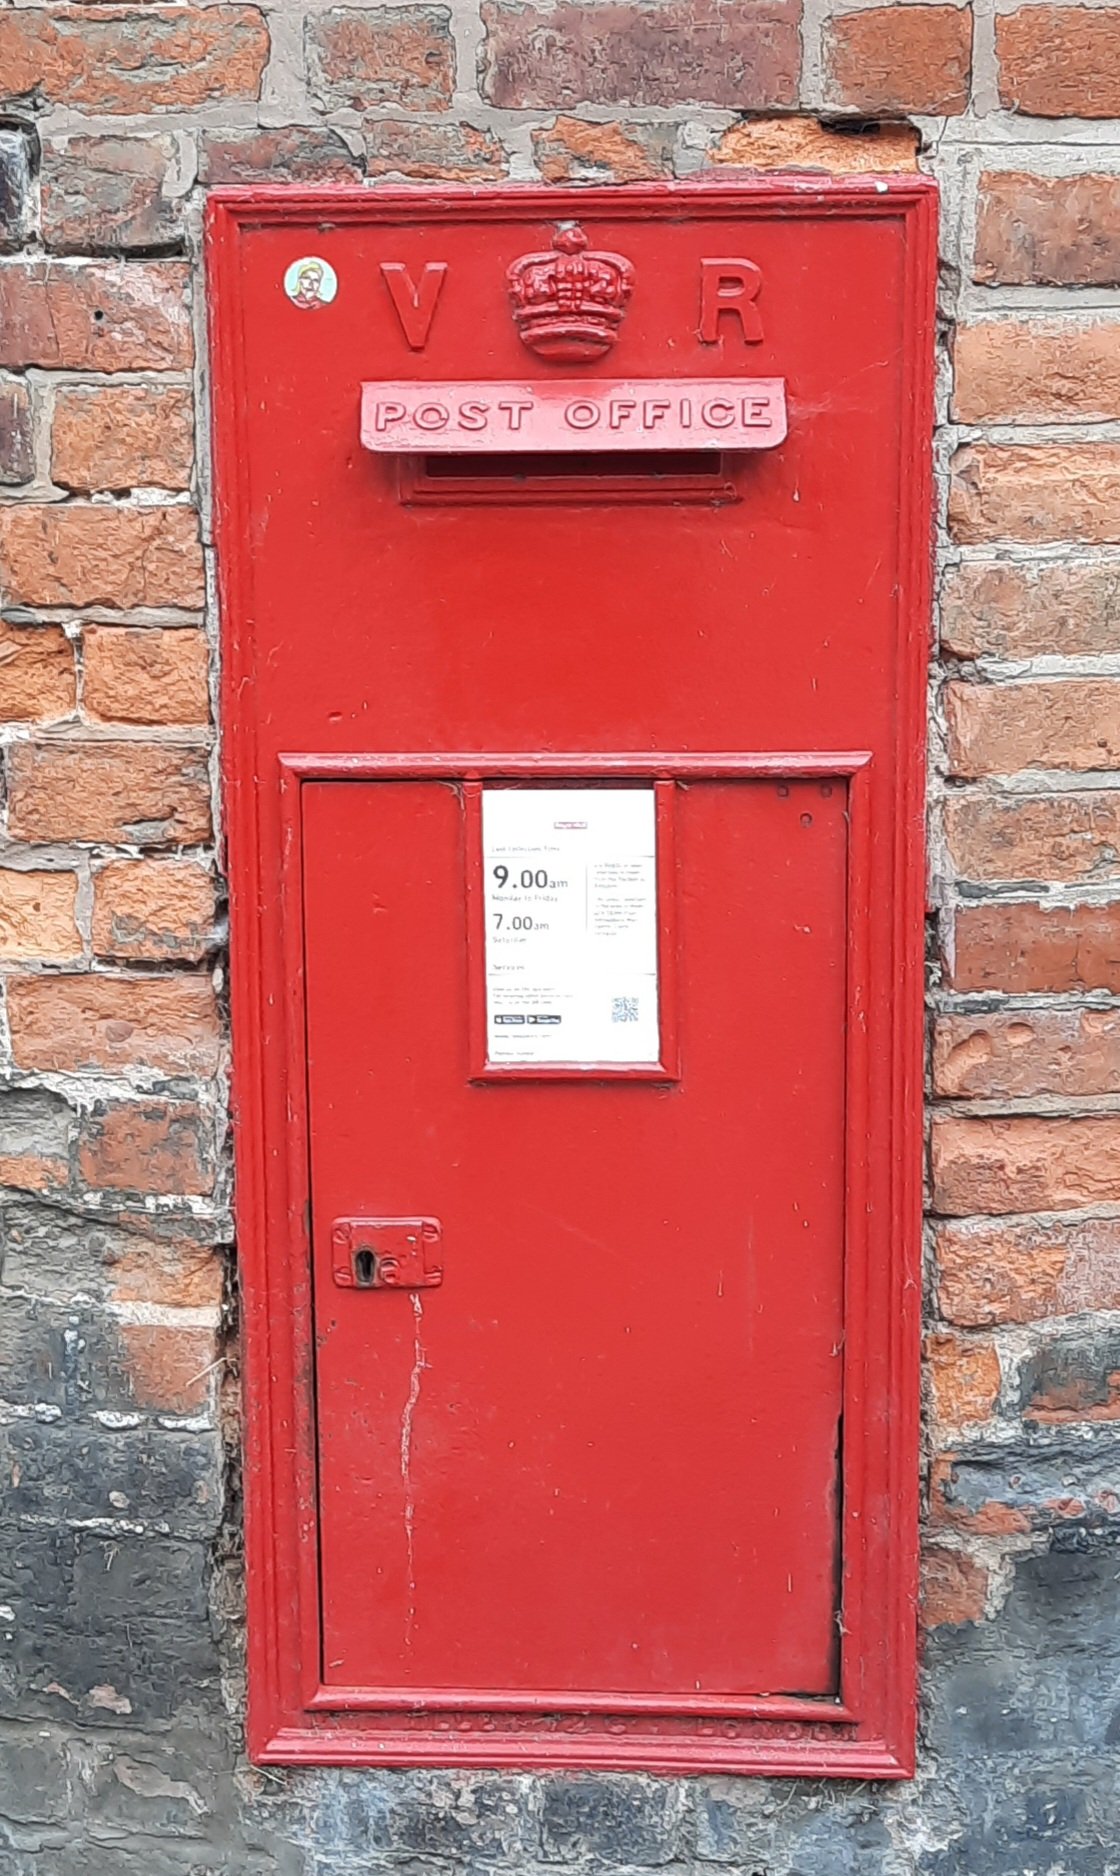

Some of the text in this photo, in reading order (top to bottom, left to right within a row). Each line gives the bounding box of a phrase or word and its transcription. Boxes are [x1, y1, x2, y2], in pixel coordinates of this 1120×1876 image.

[379, 256, 764, 351] V R
[375, 396, 772, 431] POST OFFICE
[492, 864, 568, 889] 9.00am
[492, 913, 549, 931] 7.00am
